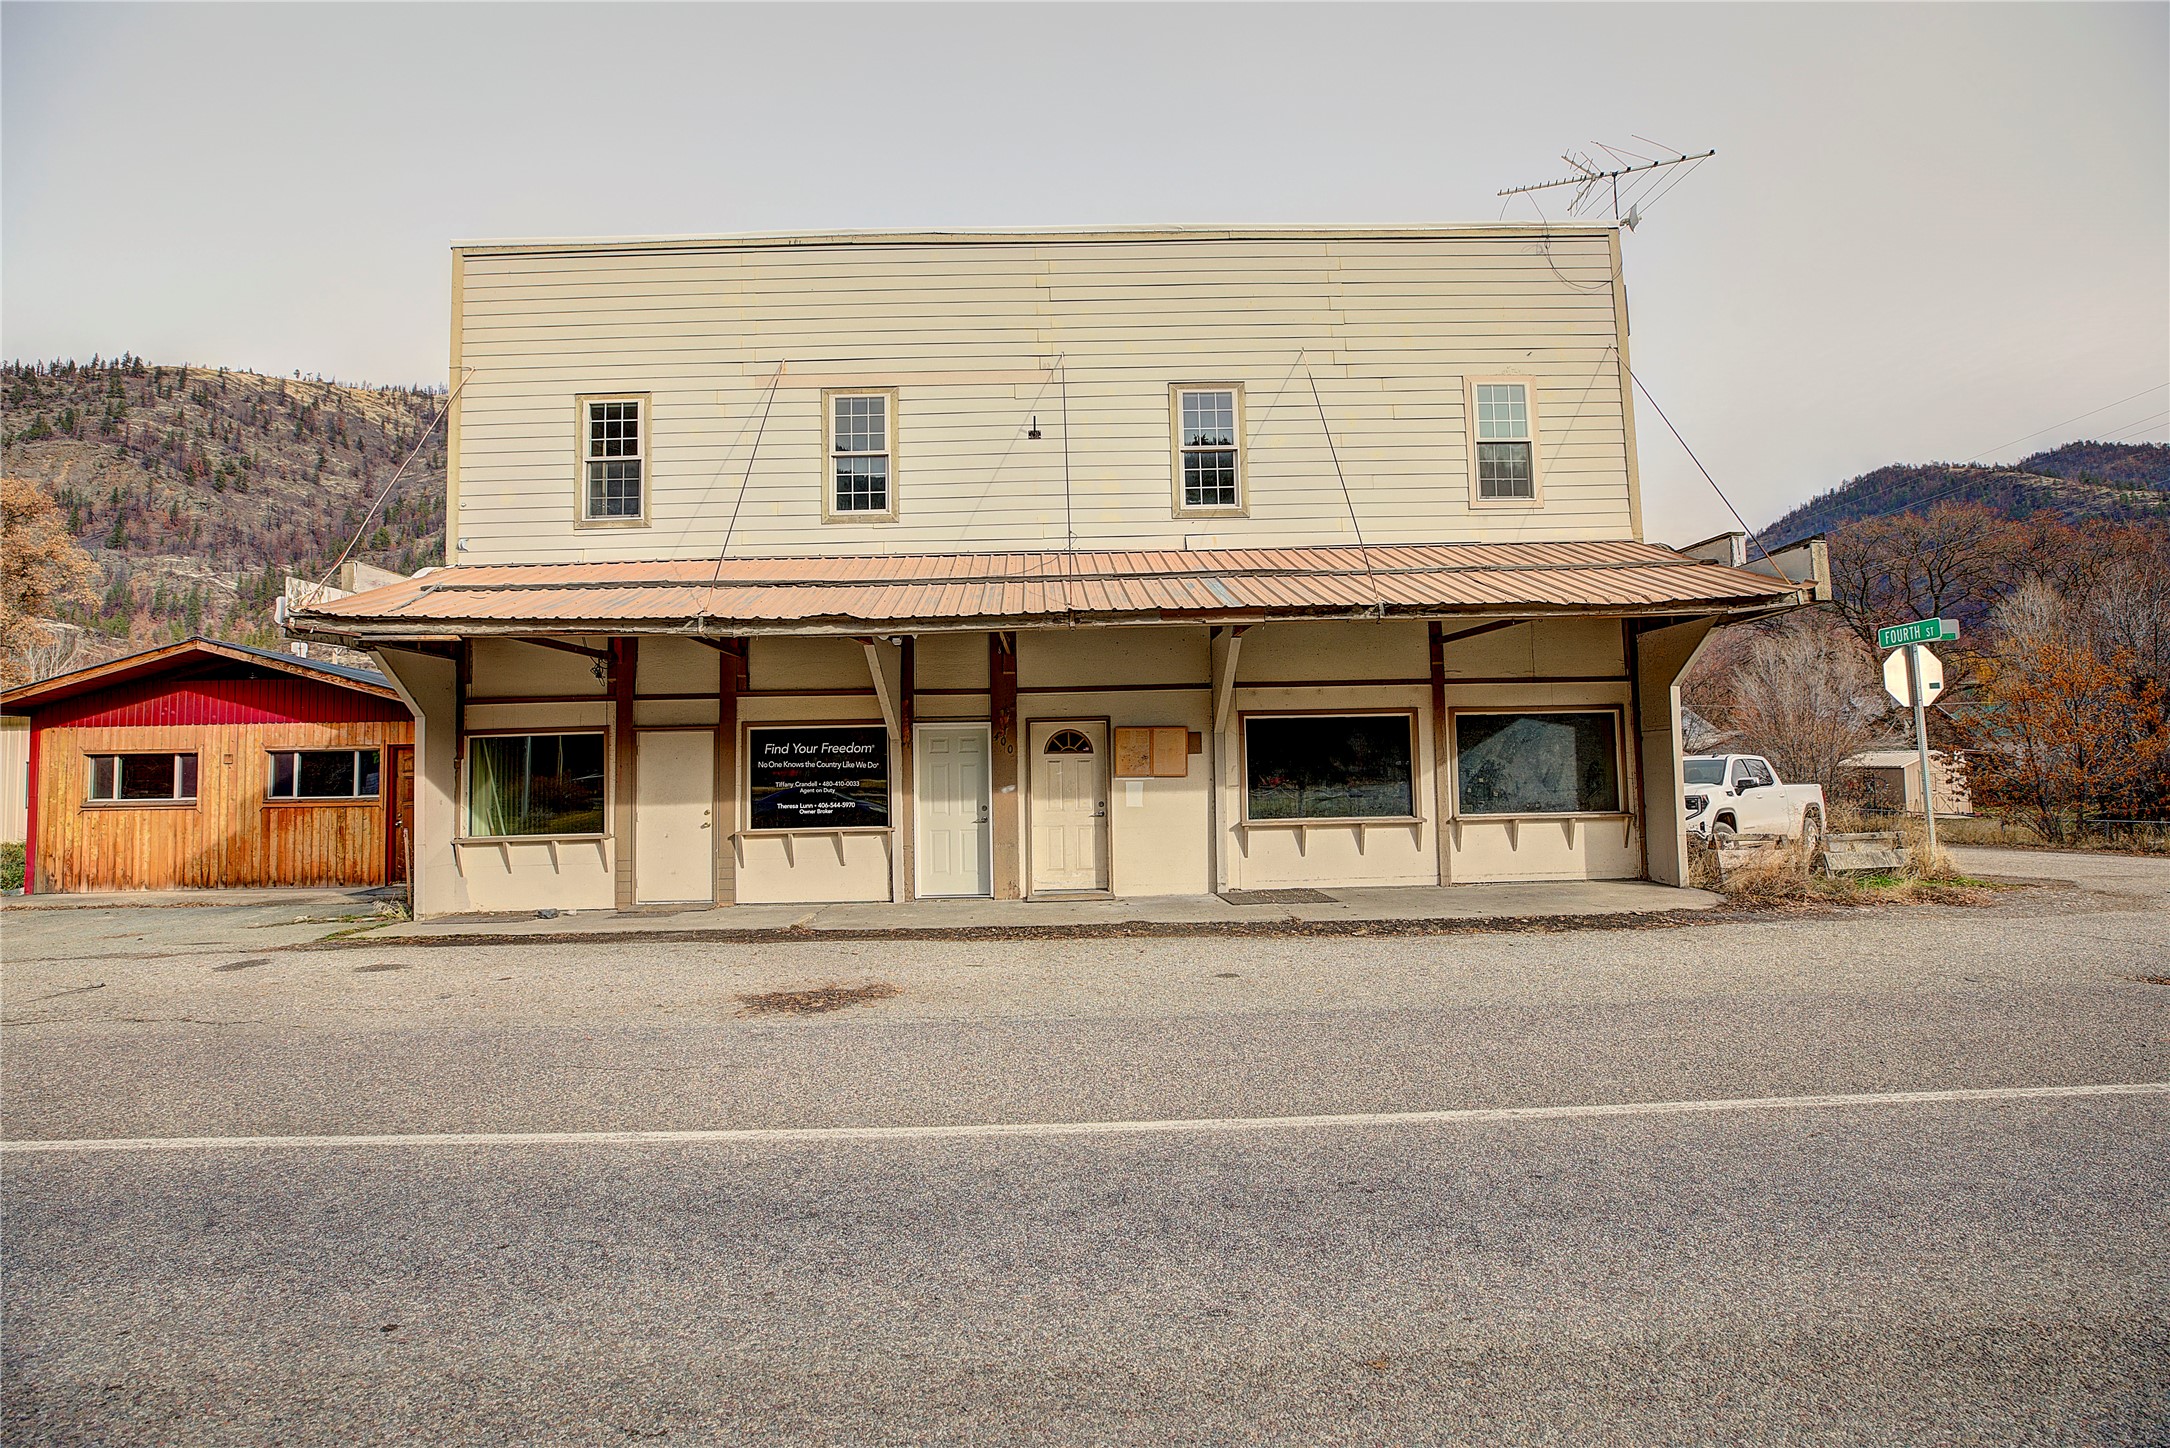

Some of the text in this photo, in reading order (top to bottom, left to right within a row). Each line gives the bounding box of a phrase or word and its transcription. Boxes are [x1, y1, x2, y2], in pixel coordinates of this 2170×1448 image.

[1885, 625, 1934, 644] FOURTH ST
[764, 743, 789, 754] Find
[792, 743, 818, 754] Your
[816, 761, 842, 770] Country
